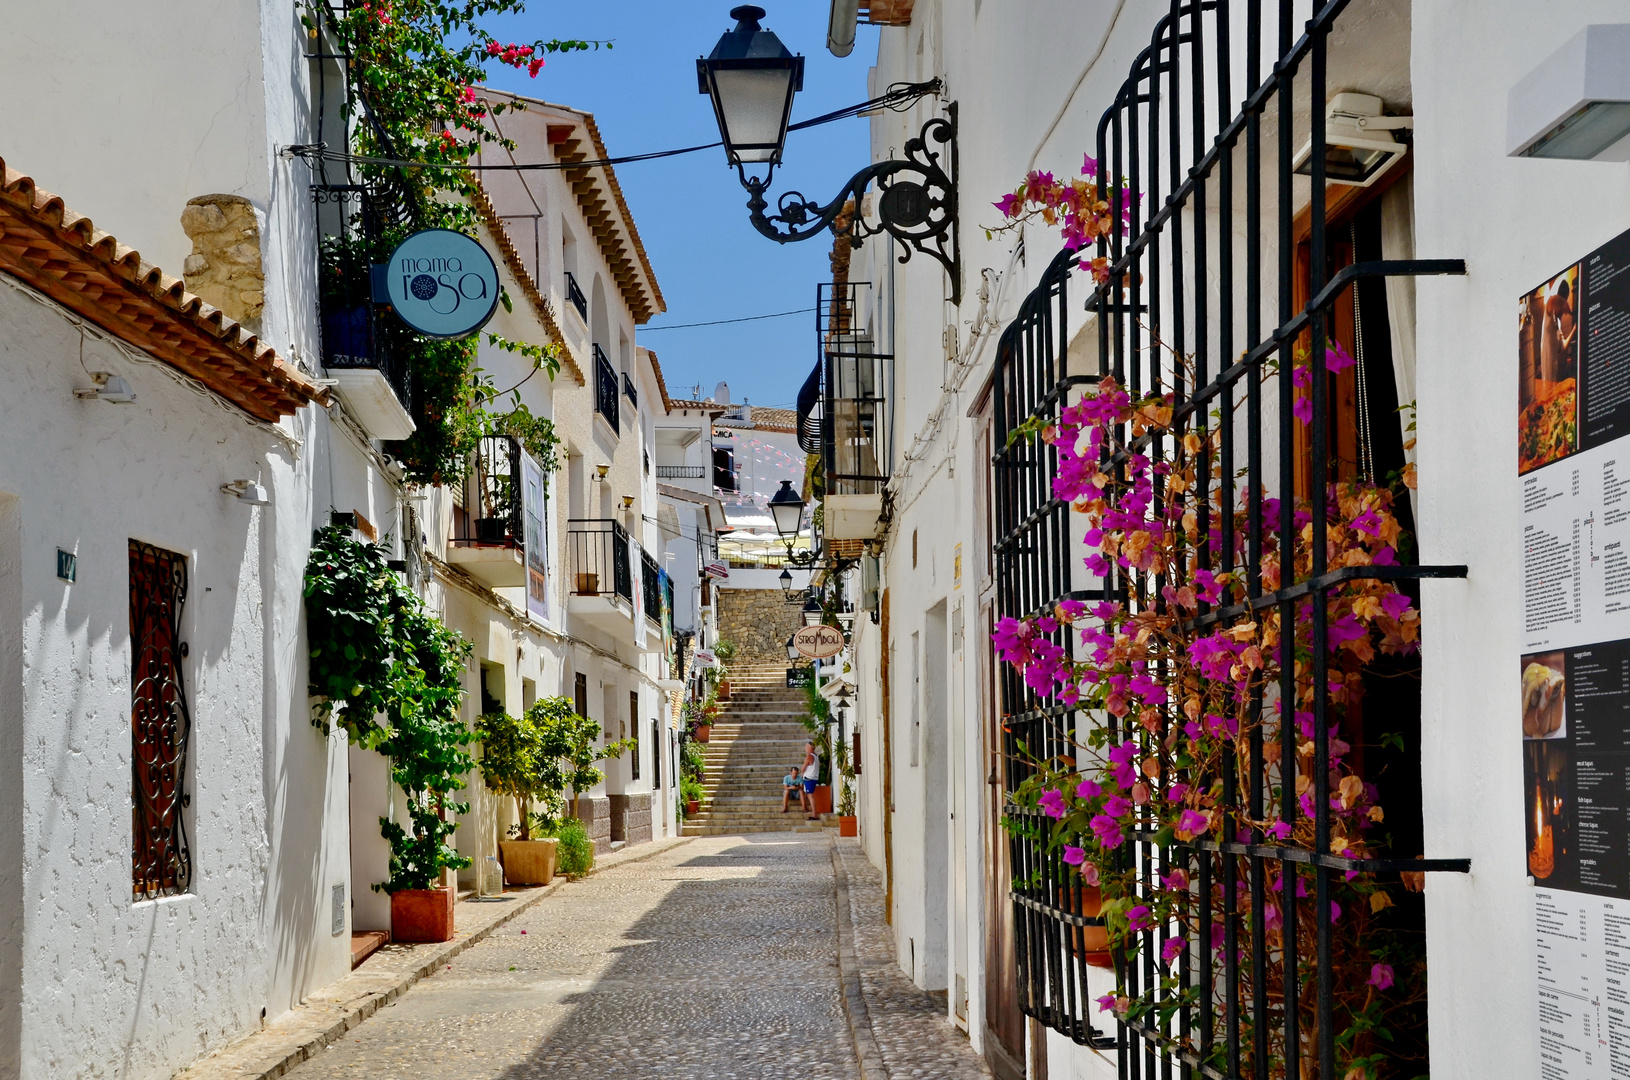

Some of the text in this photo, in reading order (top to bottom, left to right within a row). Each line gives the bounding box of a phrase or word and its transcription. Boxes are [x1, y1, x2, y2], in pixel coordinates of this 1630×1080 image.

[401, 257, 463, 273] mama
[403, 272, 487, 315] rosa
[798, 630, 839, 652] STROMBOLI
